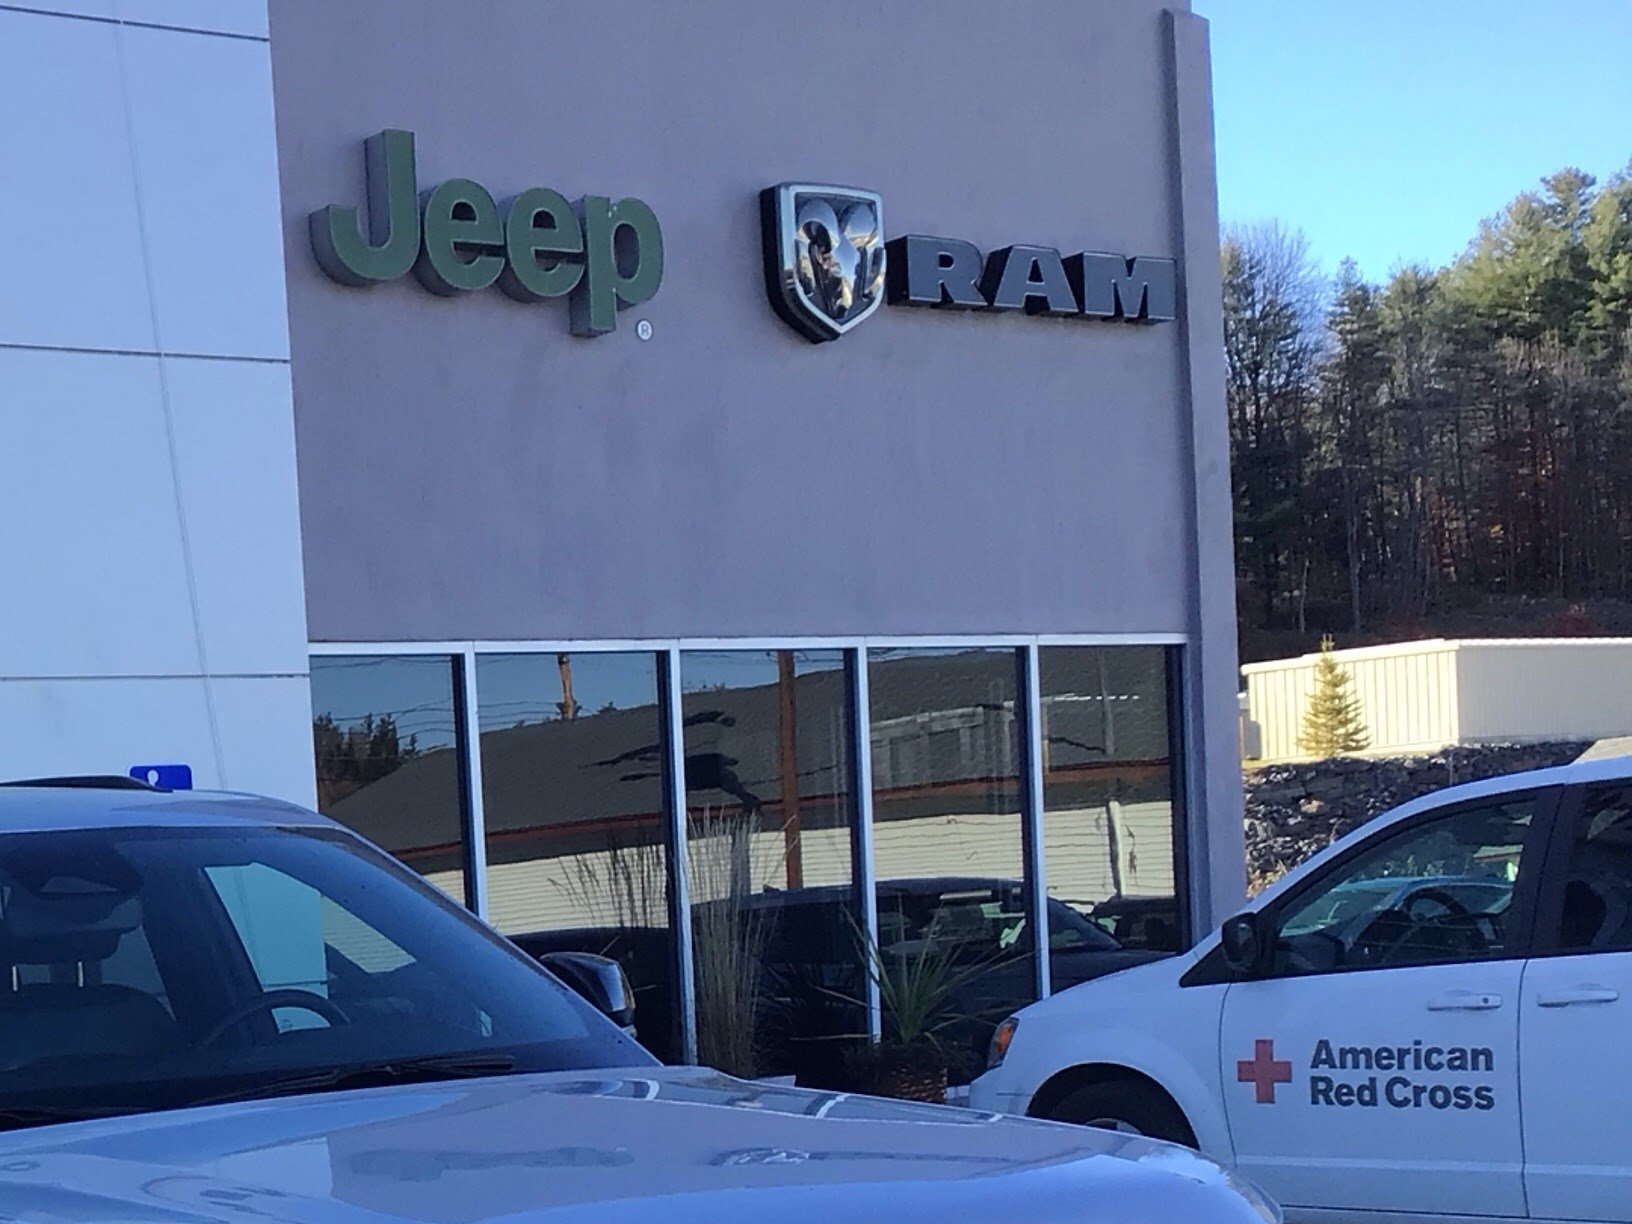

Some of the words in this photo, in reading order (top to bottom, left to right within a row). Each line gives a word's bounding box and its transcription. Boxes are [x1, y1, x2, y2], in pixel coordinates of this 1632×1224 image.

[312, 129, 663, 336] Jeep
[890, 234, 1176, 325] RAM
[1310, 1038, 1494, 1072] American
[1310, 1076, 1378, 1107] Red
[1385, 1077, 1495, 1111] Cross
